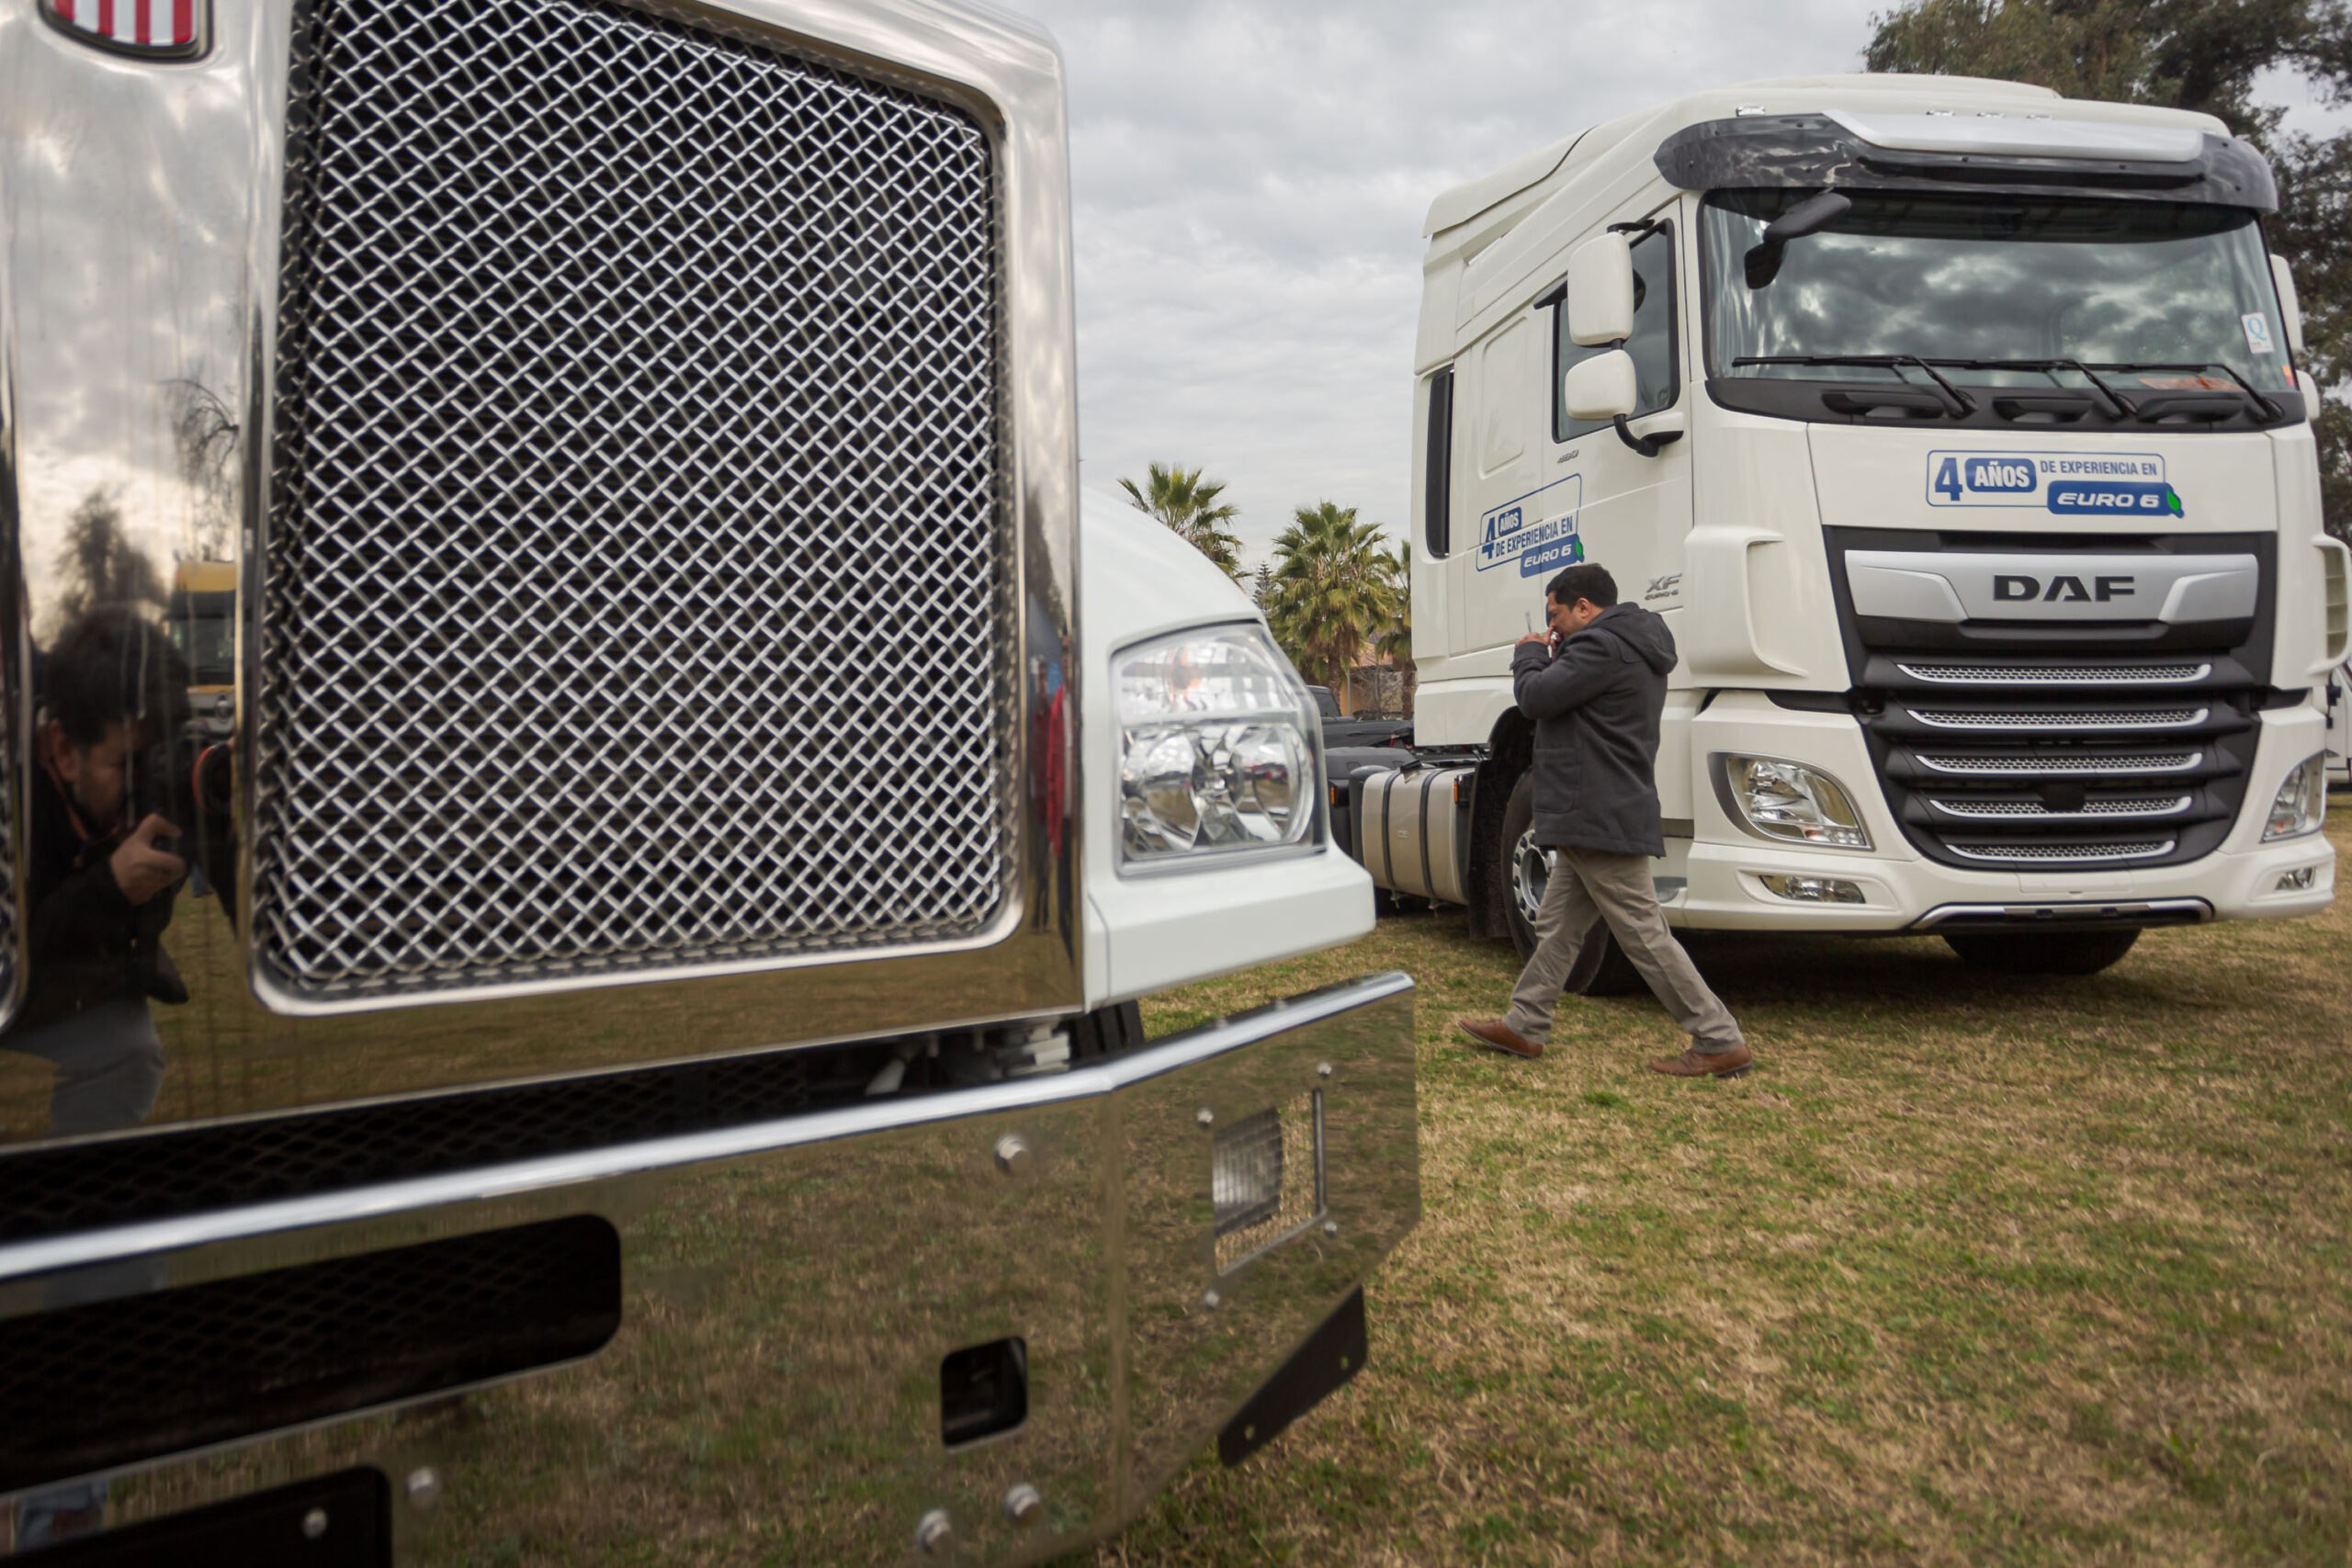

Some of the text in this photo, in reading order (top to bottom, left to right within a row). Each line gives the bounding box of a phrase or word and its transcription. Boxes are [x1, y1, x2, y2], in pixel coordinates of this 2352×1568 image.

[1935, 457, 2030, 502] 4 AÑOS
[2040, 460, 2157, 476] DE EXPERIENCIA EN
[2057, 492, 2160, 508] EURO 6
[1482, 512, 1520, 559] 4 AÑOS
[1496, 515, 1573, 558] DE EXPERIENCIA EN
[1523, 544, 1572, 567] EURO 6
[1646, 573, 1682, 592] XF
[1993, 574, 2135, 603] DAF
